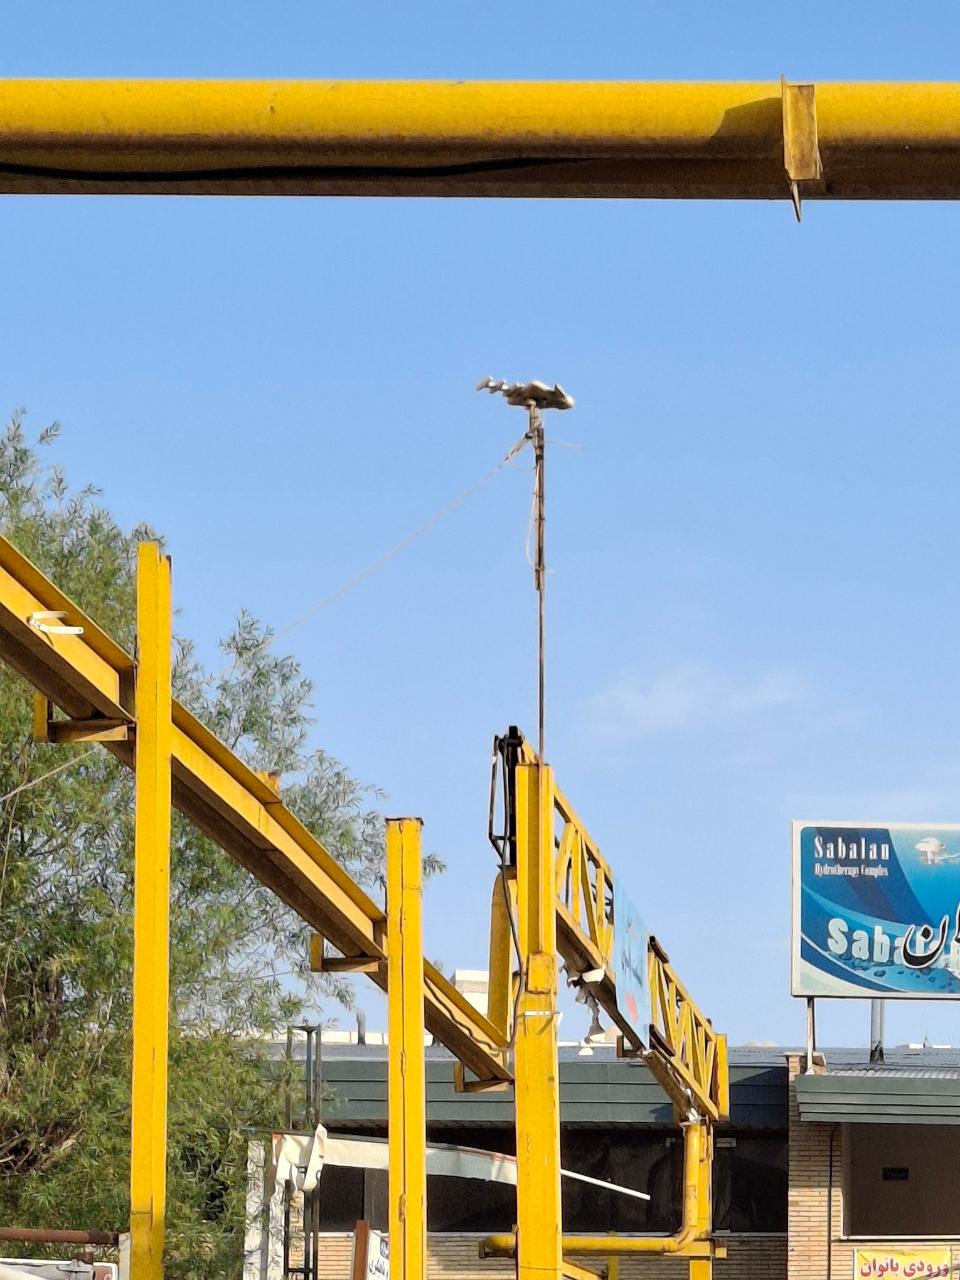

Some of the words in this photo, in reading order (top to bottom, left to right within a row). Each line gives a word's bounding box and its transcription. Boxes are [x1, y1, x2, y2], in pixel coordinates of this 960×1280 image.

[814, 836, 890, 861] Sabalan
[860, 862, 889, 877] Complex
[860, 1258, 899, 1277] بانوان
[903, 1260, 949, 1277] ورودی
